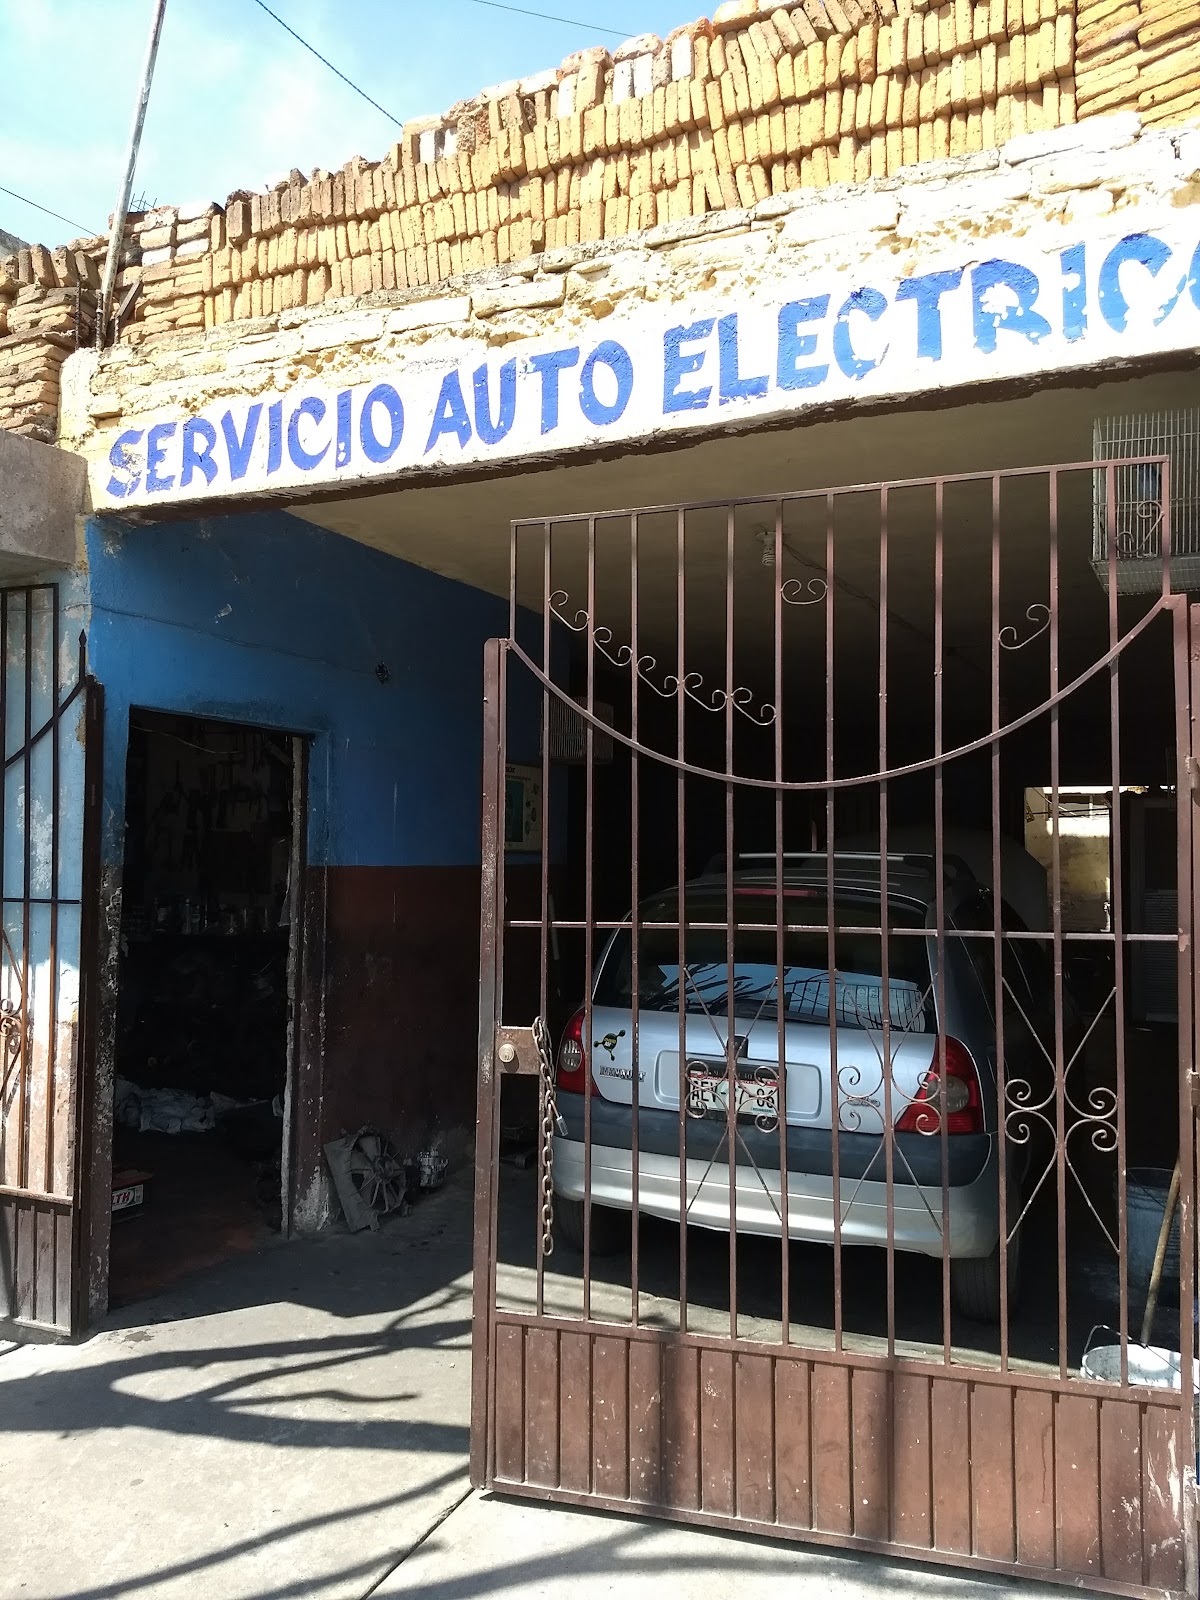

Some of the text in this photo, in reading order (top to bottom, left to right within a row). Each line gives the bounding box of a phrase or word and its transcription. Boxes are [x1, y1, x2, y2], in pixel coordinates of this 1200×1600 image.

[106, 232, 1200, 498] SERVICIO AUTO ELECTRIC
